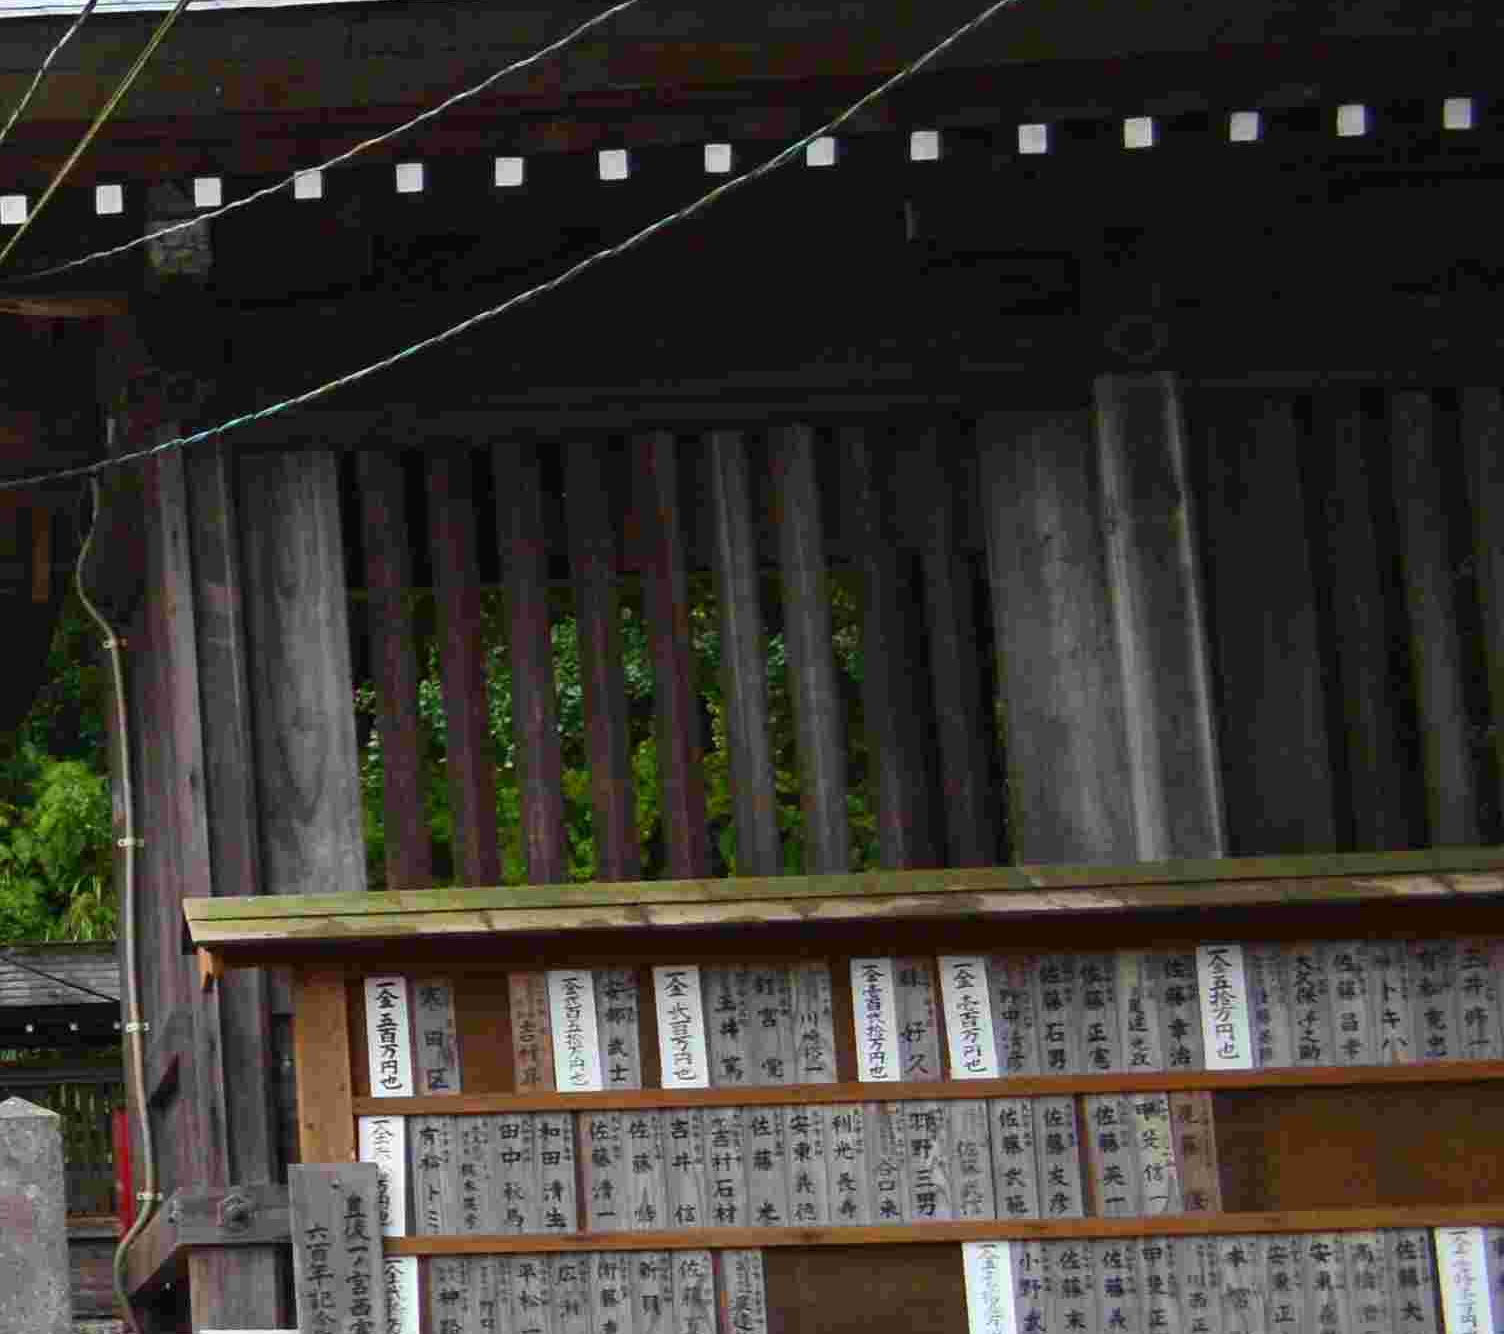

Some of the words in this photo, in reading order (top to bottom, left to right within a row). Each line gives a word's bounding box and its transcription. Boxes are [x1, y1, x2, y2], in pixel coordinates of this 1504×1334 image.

[374, 981, 403, 1092] 一金五百万円也
